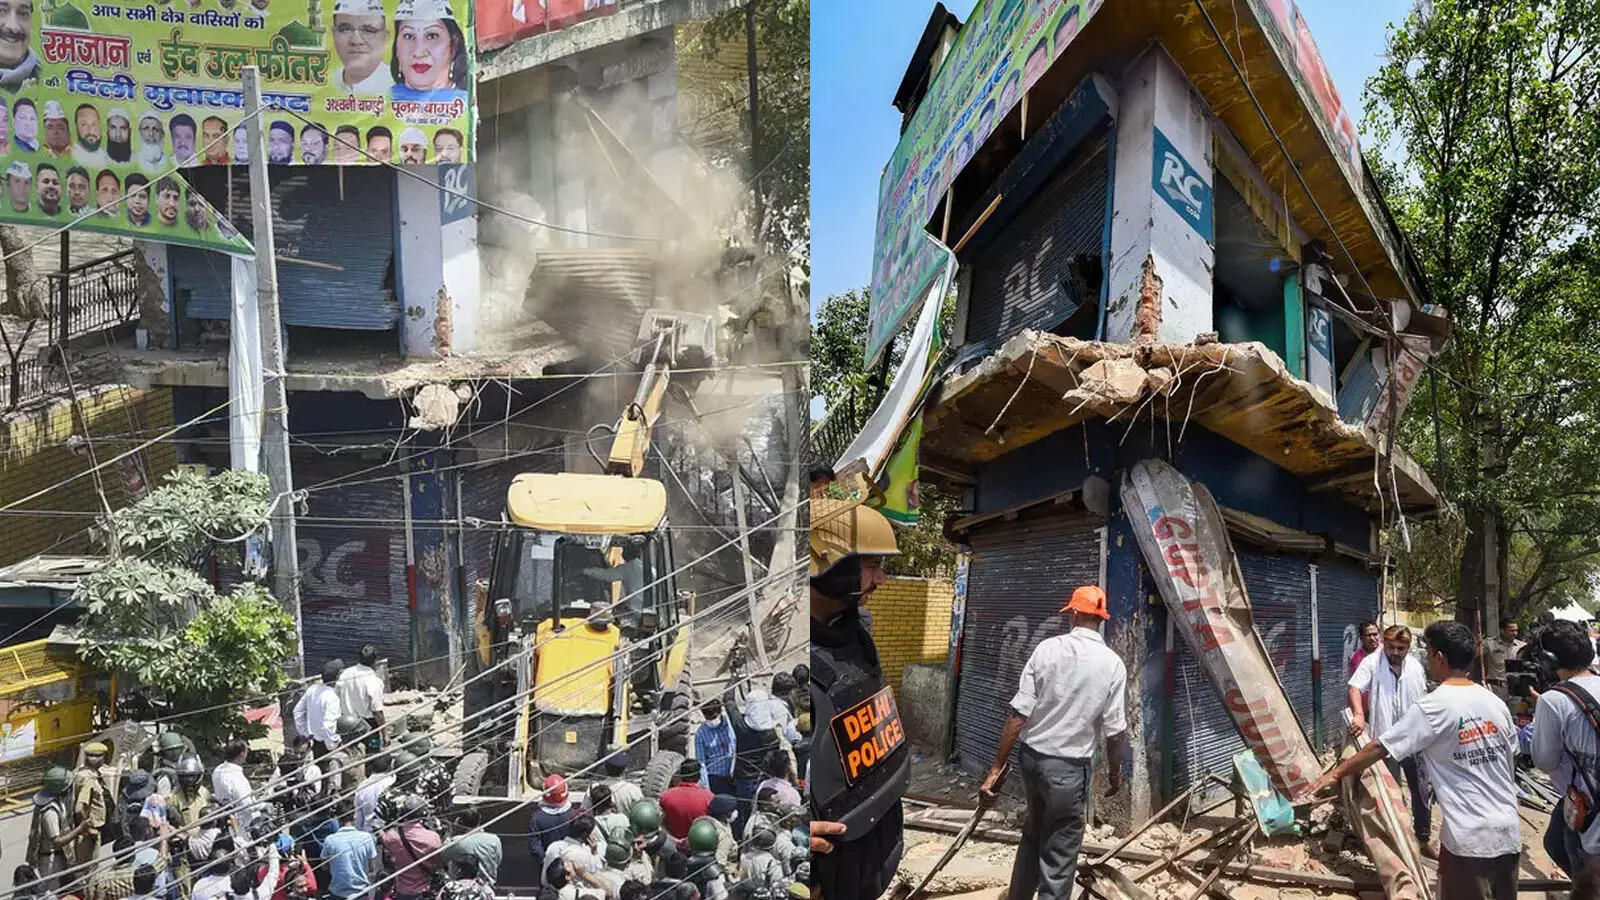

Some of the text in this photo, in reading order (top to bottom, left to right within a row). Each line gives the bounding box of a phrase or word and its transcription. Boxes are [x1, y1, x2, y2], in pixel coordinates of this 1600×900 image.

[91, 5, 265, 29] आप सभी क्षेत्र वासियों को
[41, 29, 132, 70] रमजान
[136, 49, 152, 64] एवं
[159, 28, 200, 80] ईद
[1160, 151, 1204, 213] RC
[843, 694, 893, 742] DELHI
[848, 718, 903, 779] POLICE
